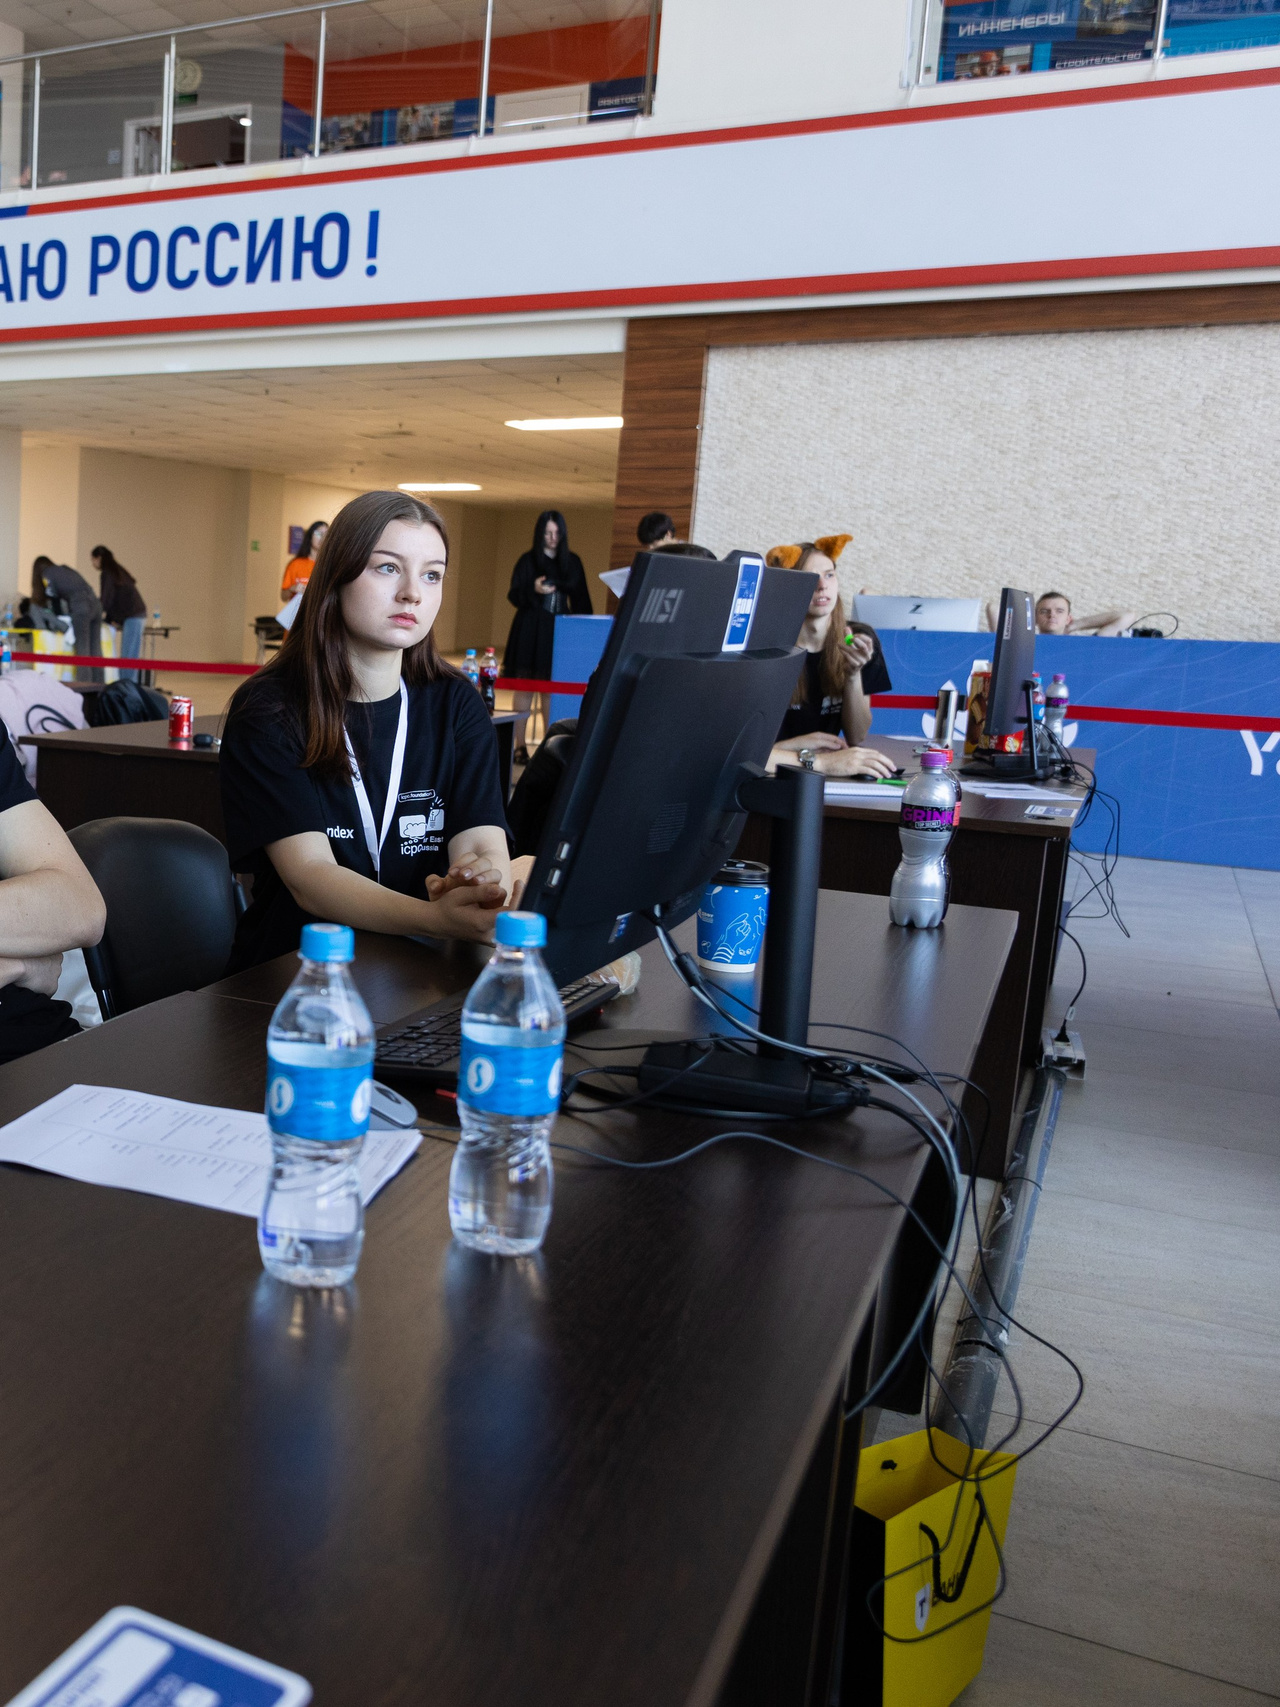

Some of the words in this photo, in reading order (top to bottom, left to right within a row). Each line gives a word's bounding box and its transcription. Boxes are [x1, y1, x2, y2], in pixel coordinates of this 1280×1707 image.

[958, 12, 1065, 37] ИНЖЕНЕРЫ
[1054, 50, 1141, 70] СТРОИТЕЛЬСТВО
[89, 210, 381, 296] РОССИЮ!
[639, 588, 685, 623] MSI
[1239, 729, 1280, 777] Y
[326, 825, 355, 839] ndex
